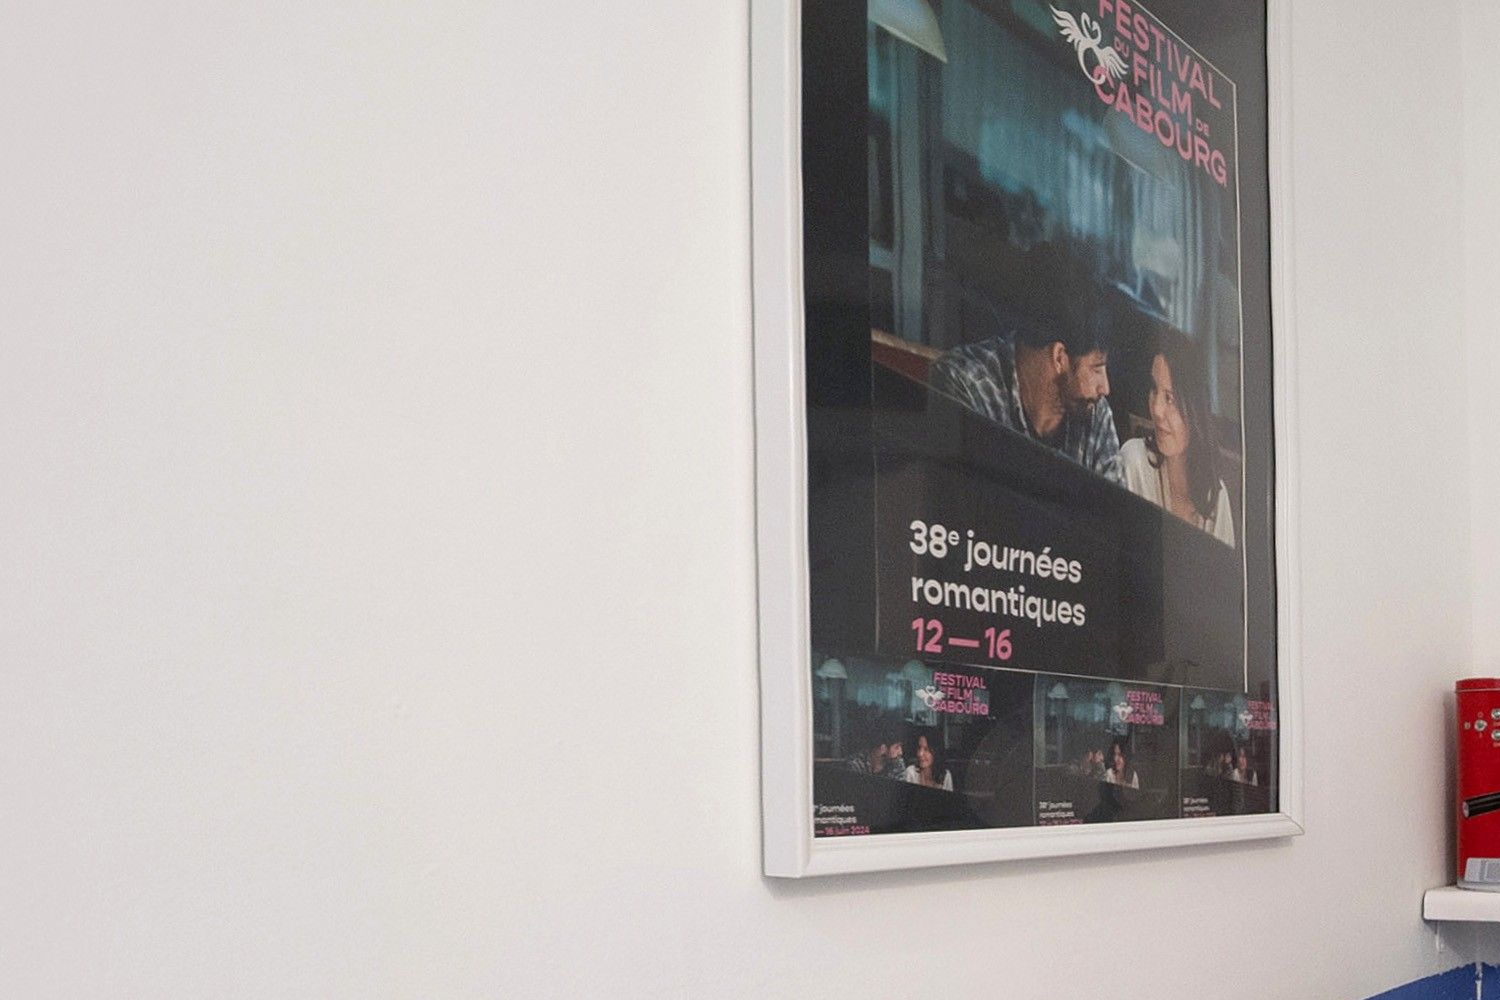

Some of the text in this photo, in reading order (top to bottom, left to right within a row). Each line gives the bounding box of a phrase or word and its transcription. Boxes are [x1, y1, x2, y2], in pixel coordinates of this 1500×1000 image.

[1099, 0, 1222, 110] FESTIVAL
[1133, 53, 1193, 126] FILM
[1093, 65, 1228, 188] CABOURG
[964, 529, 1082, 584] journées
[911, 576, 1087, 628] romantiques
[933, 672, 987, 689] FESTIVAL
[947, 687, 974, 702] FILM
